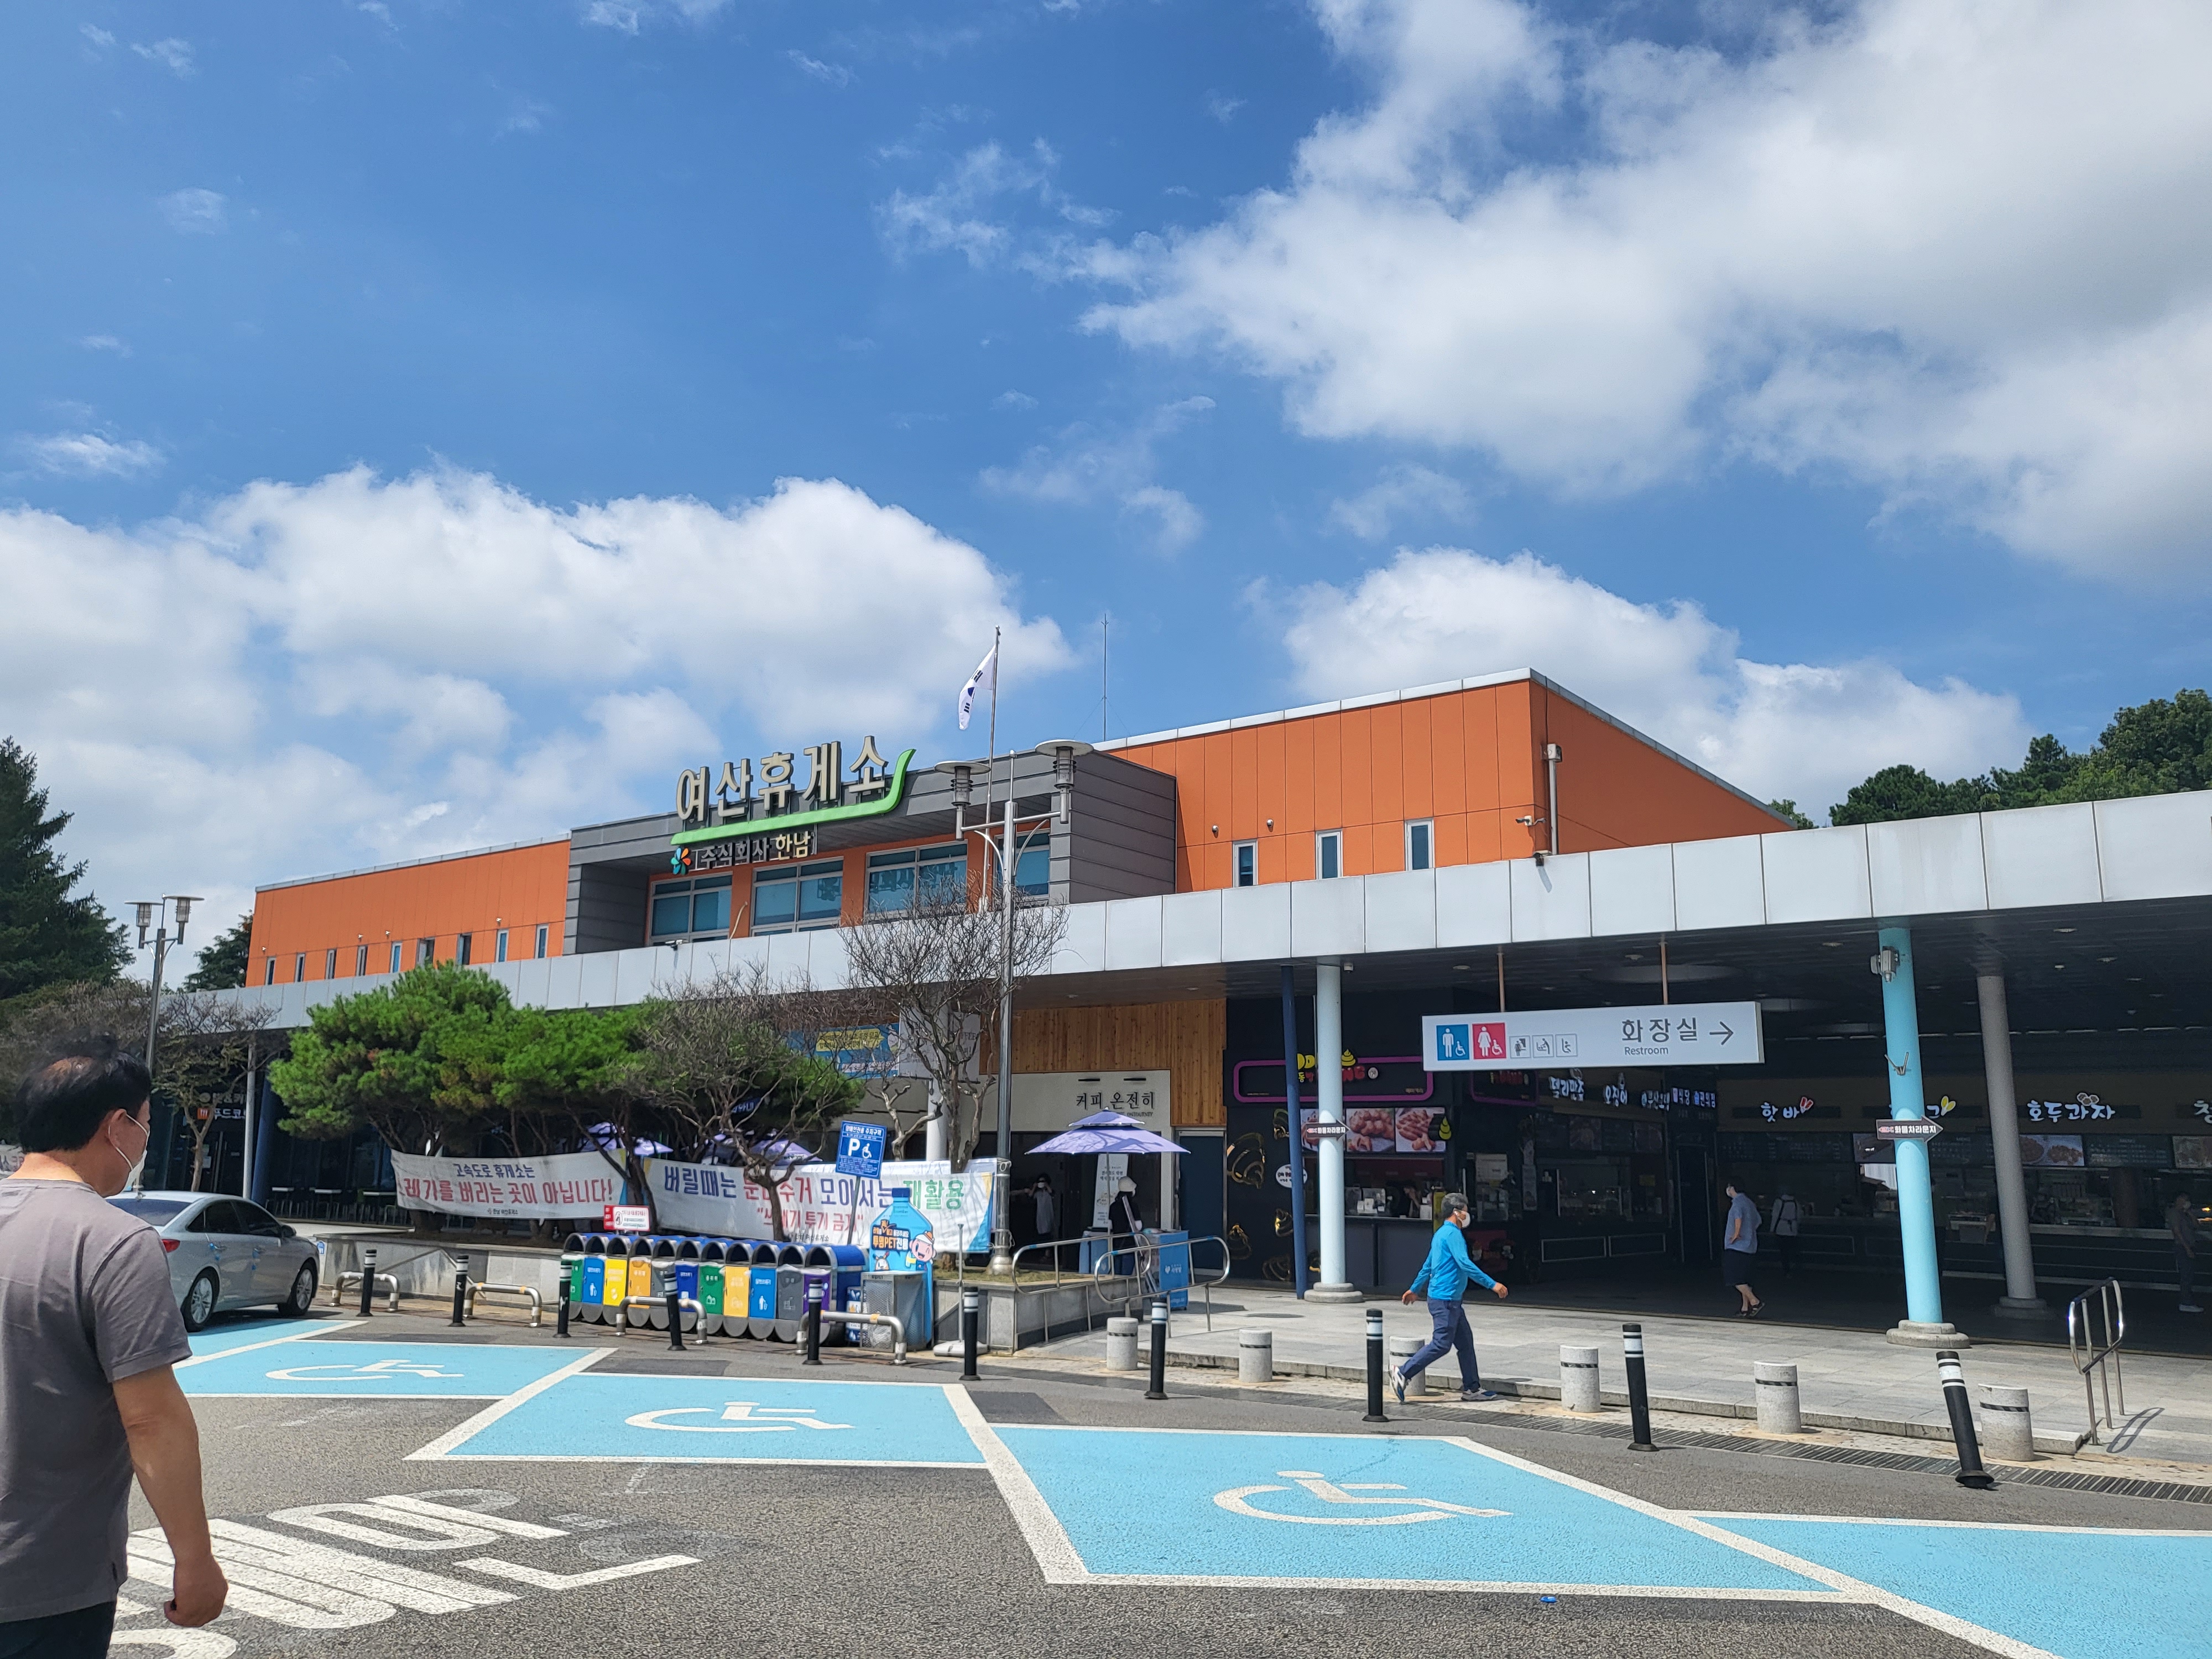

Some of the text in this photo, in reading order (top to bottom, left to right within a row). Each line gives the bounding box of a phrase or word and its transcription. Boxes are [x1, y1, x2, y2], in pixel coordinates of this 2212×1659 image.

[676, 735, 889, 822] 여산휴게소
[700, 830, 814, 870] 주식회사 한남
[1621, 1018, 1697, 1042] 화장실
[1624, 1045, 1669, 1056] Restroom
[1076, 1092, 1154, 1109] 커피 온전히
[1605, 1084, 1627, 1107] 오징어
[2027, 1100, 2115, 1123] 호두과자
[845, 1125, 865, 1134] 장애인전용
[865, 1128, 882, 1136] 주차구역
[1895, 1125, 1937, 1134] 화물차라운지
[847, 1138, 860, 1156] P
[453, 1163, 536, 1178] 고속도로 휴게소는
[458, 1181, 504, 1204] 버리는
[508, 1182, 539, 1204] 곳이
[543, 1178, 613, 1204] 아닙니다!
[664, 1165, 737, 1197] 버릴때는
[820, 1178, 893, 1208] 모아서는
[902, 1179, 964, 1210] 재활용
[805, 1210, 829, 1230] 투기
